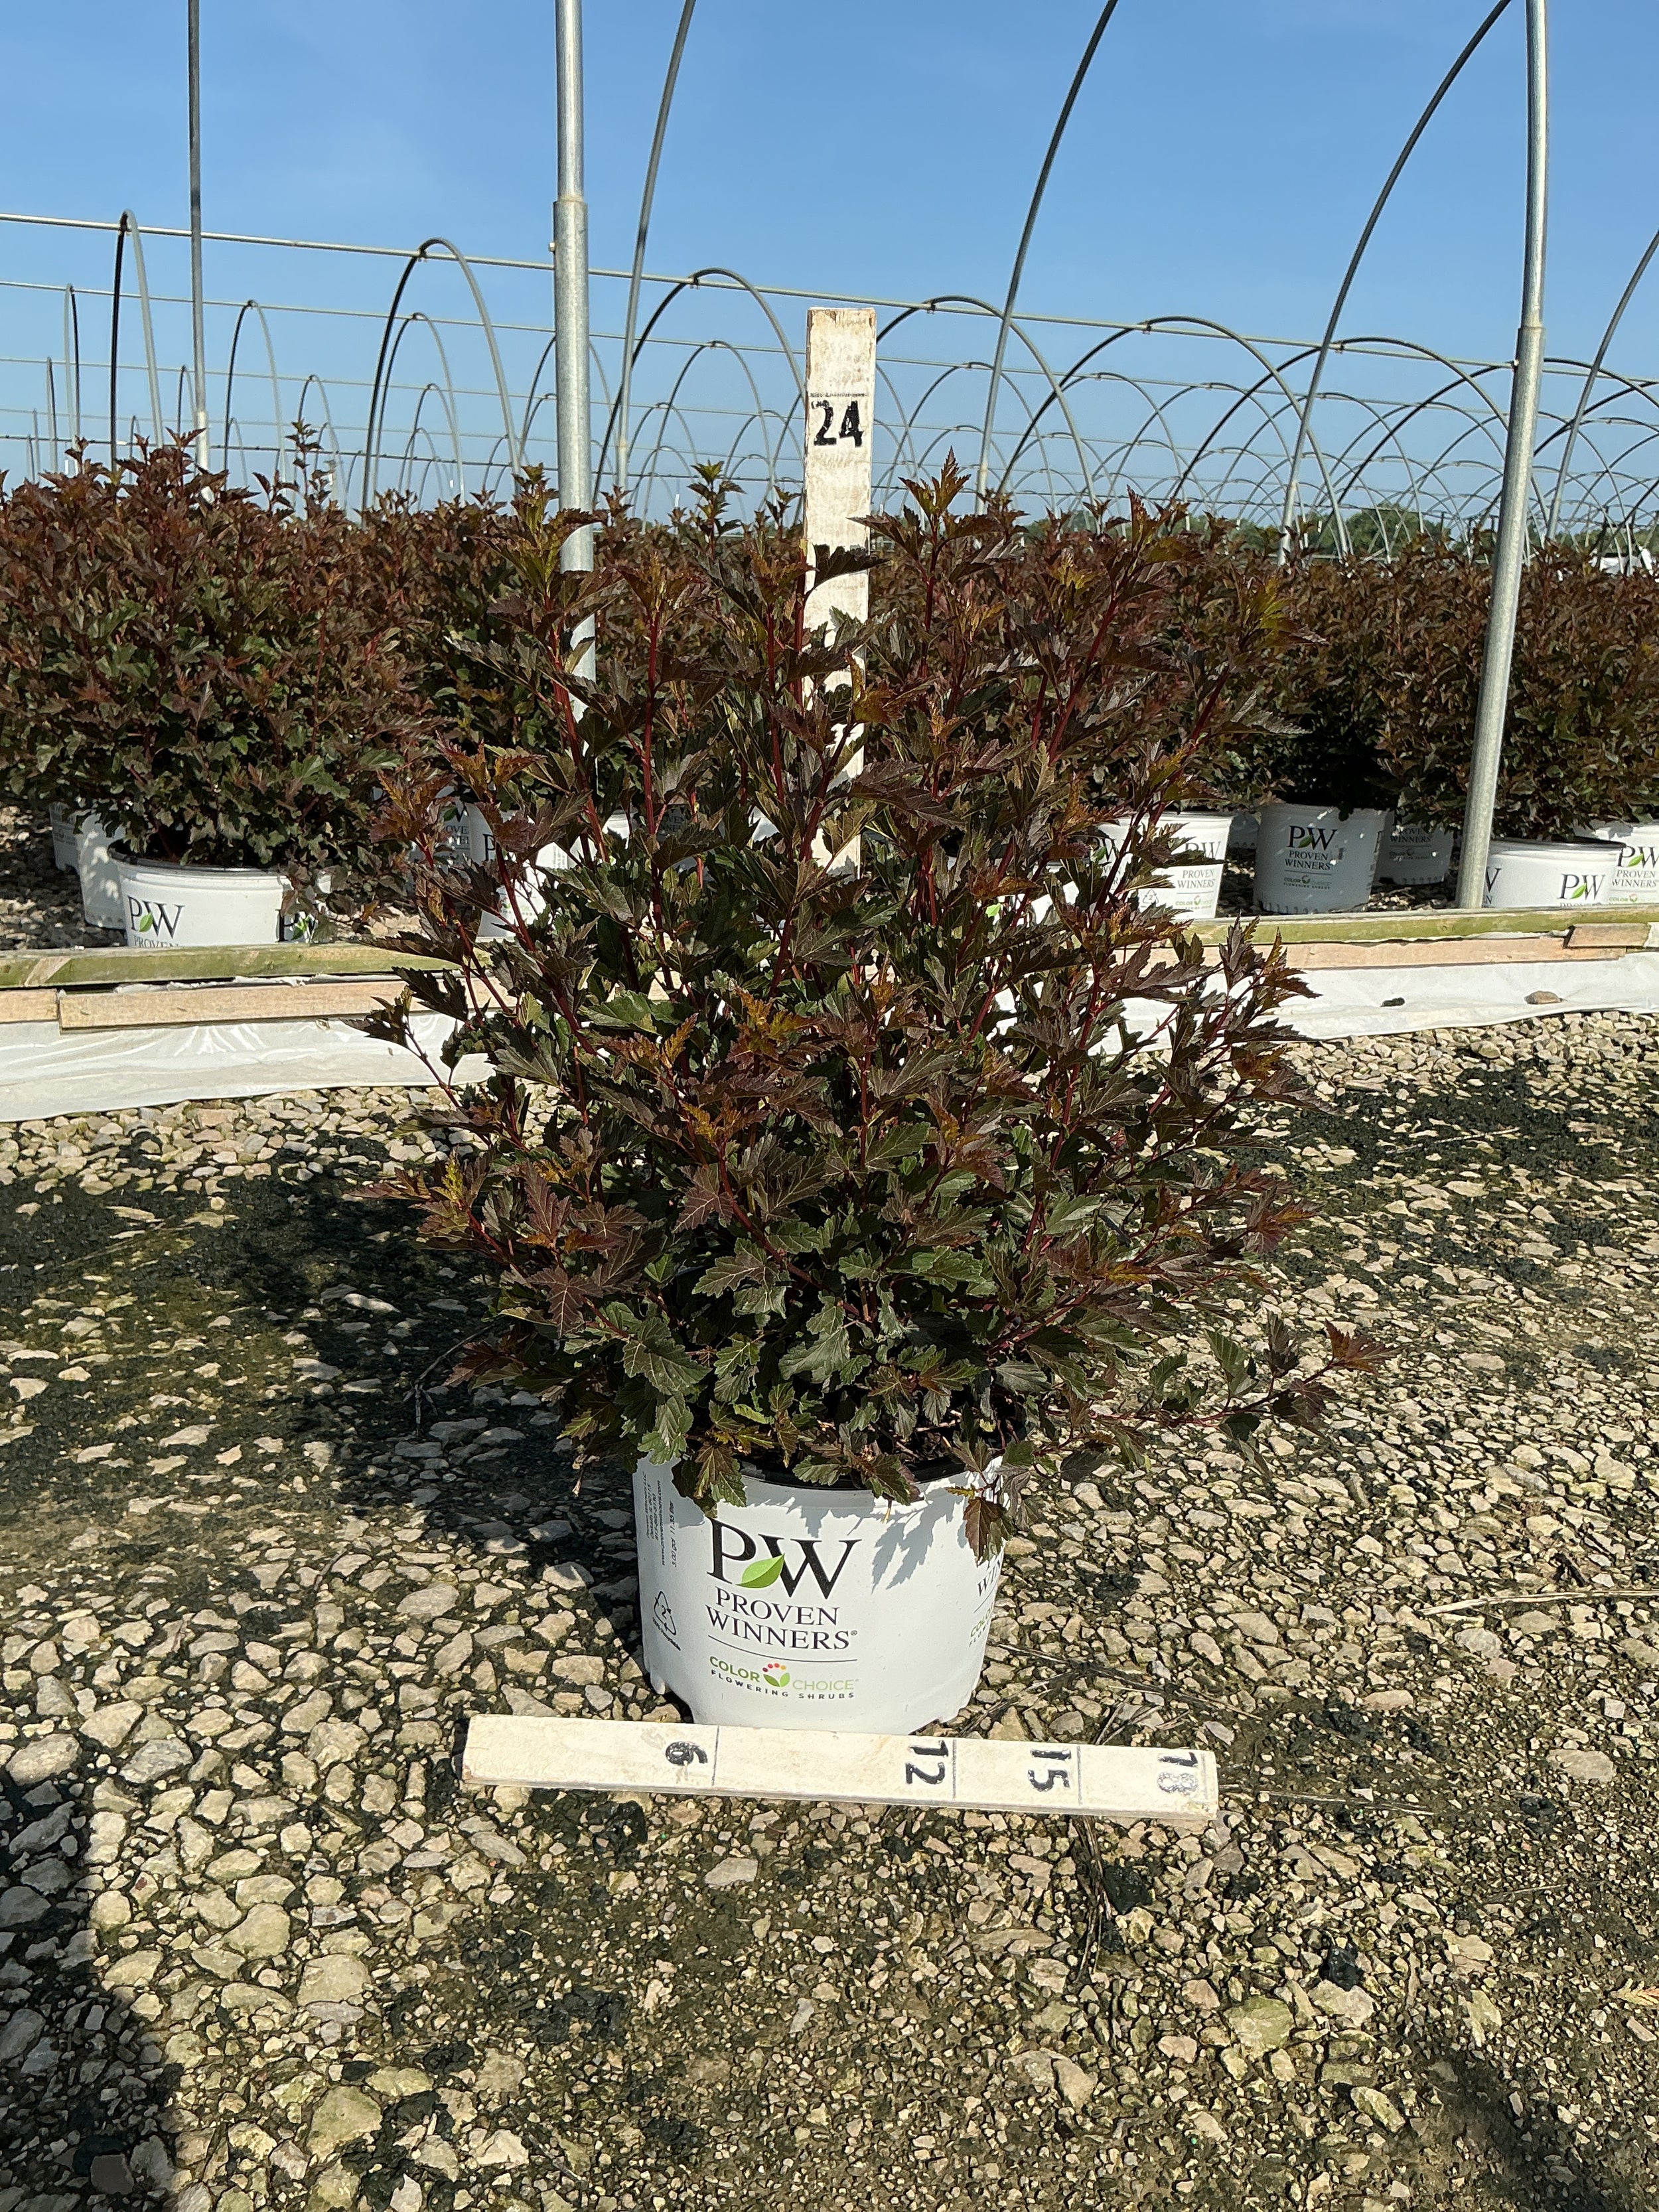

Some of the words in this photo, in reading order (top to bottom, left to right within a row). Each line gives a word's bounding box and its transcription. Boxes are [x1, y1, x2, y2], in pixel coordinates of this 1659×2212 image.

[811, 400, 864, 447] 24
[1287, 825, 1338, 851] PW
[1285, 858, 1331, 870] WINNERS
[1289, 849, 1329, 861] PROVEN
[1182, 869, 1214, 879] PROVEN
[1557, 873, 1605, 901] PW
[1611, 878, 1657, 888] WINNERS
[1617, 869, 1656, 879] PROVEN
[127, 895, 185, 939] PW
[657, 1479, 666, 1566] www.provenwinners.com
[706, 1516, 863, 1600] PW
[715, 1585, 841, 1626] PROVEN
[709, 1656, 760, 1683] COLOR
[711, 1668, 790, 1698] FLOWERING
[665, 1741, 709, 1767] 6
[905, 1739, 949, 1785] 12
[1028, 1748, 1072, 1792] 15
[1157, 1751, 1198, 1795] 18
